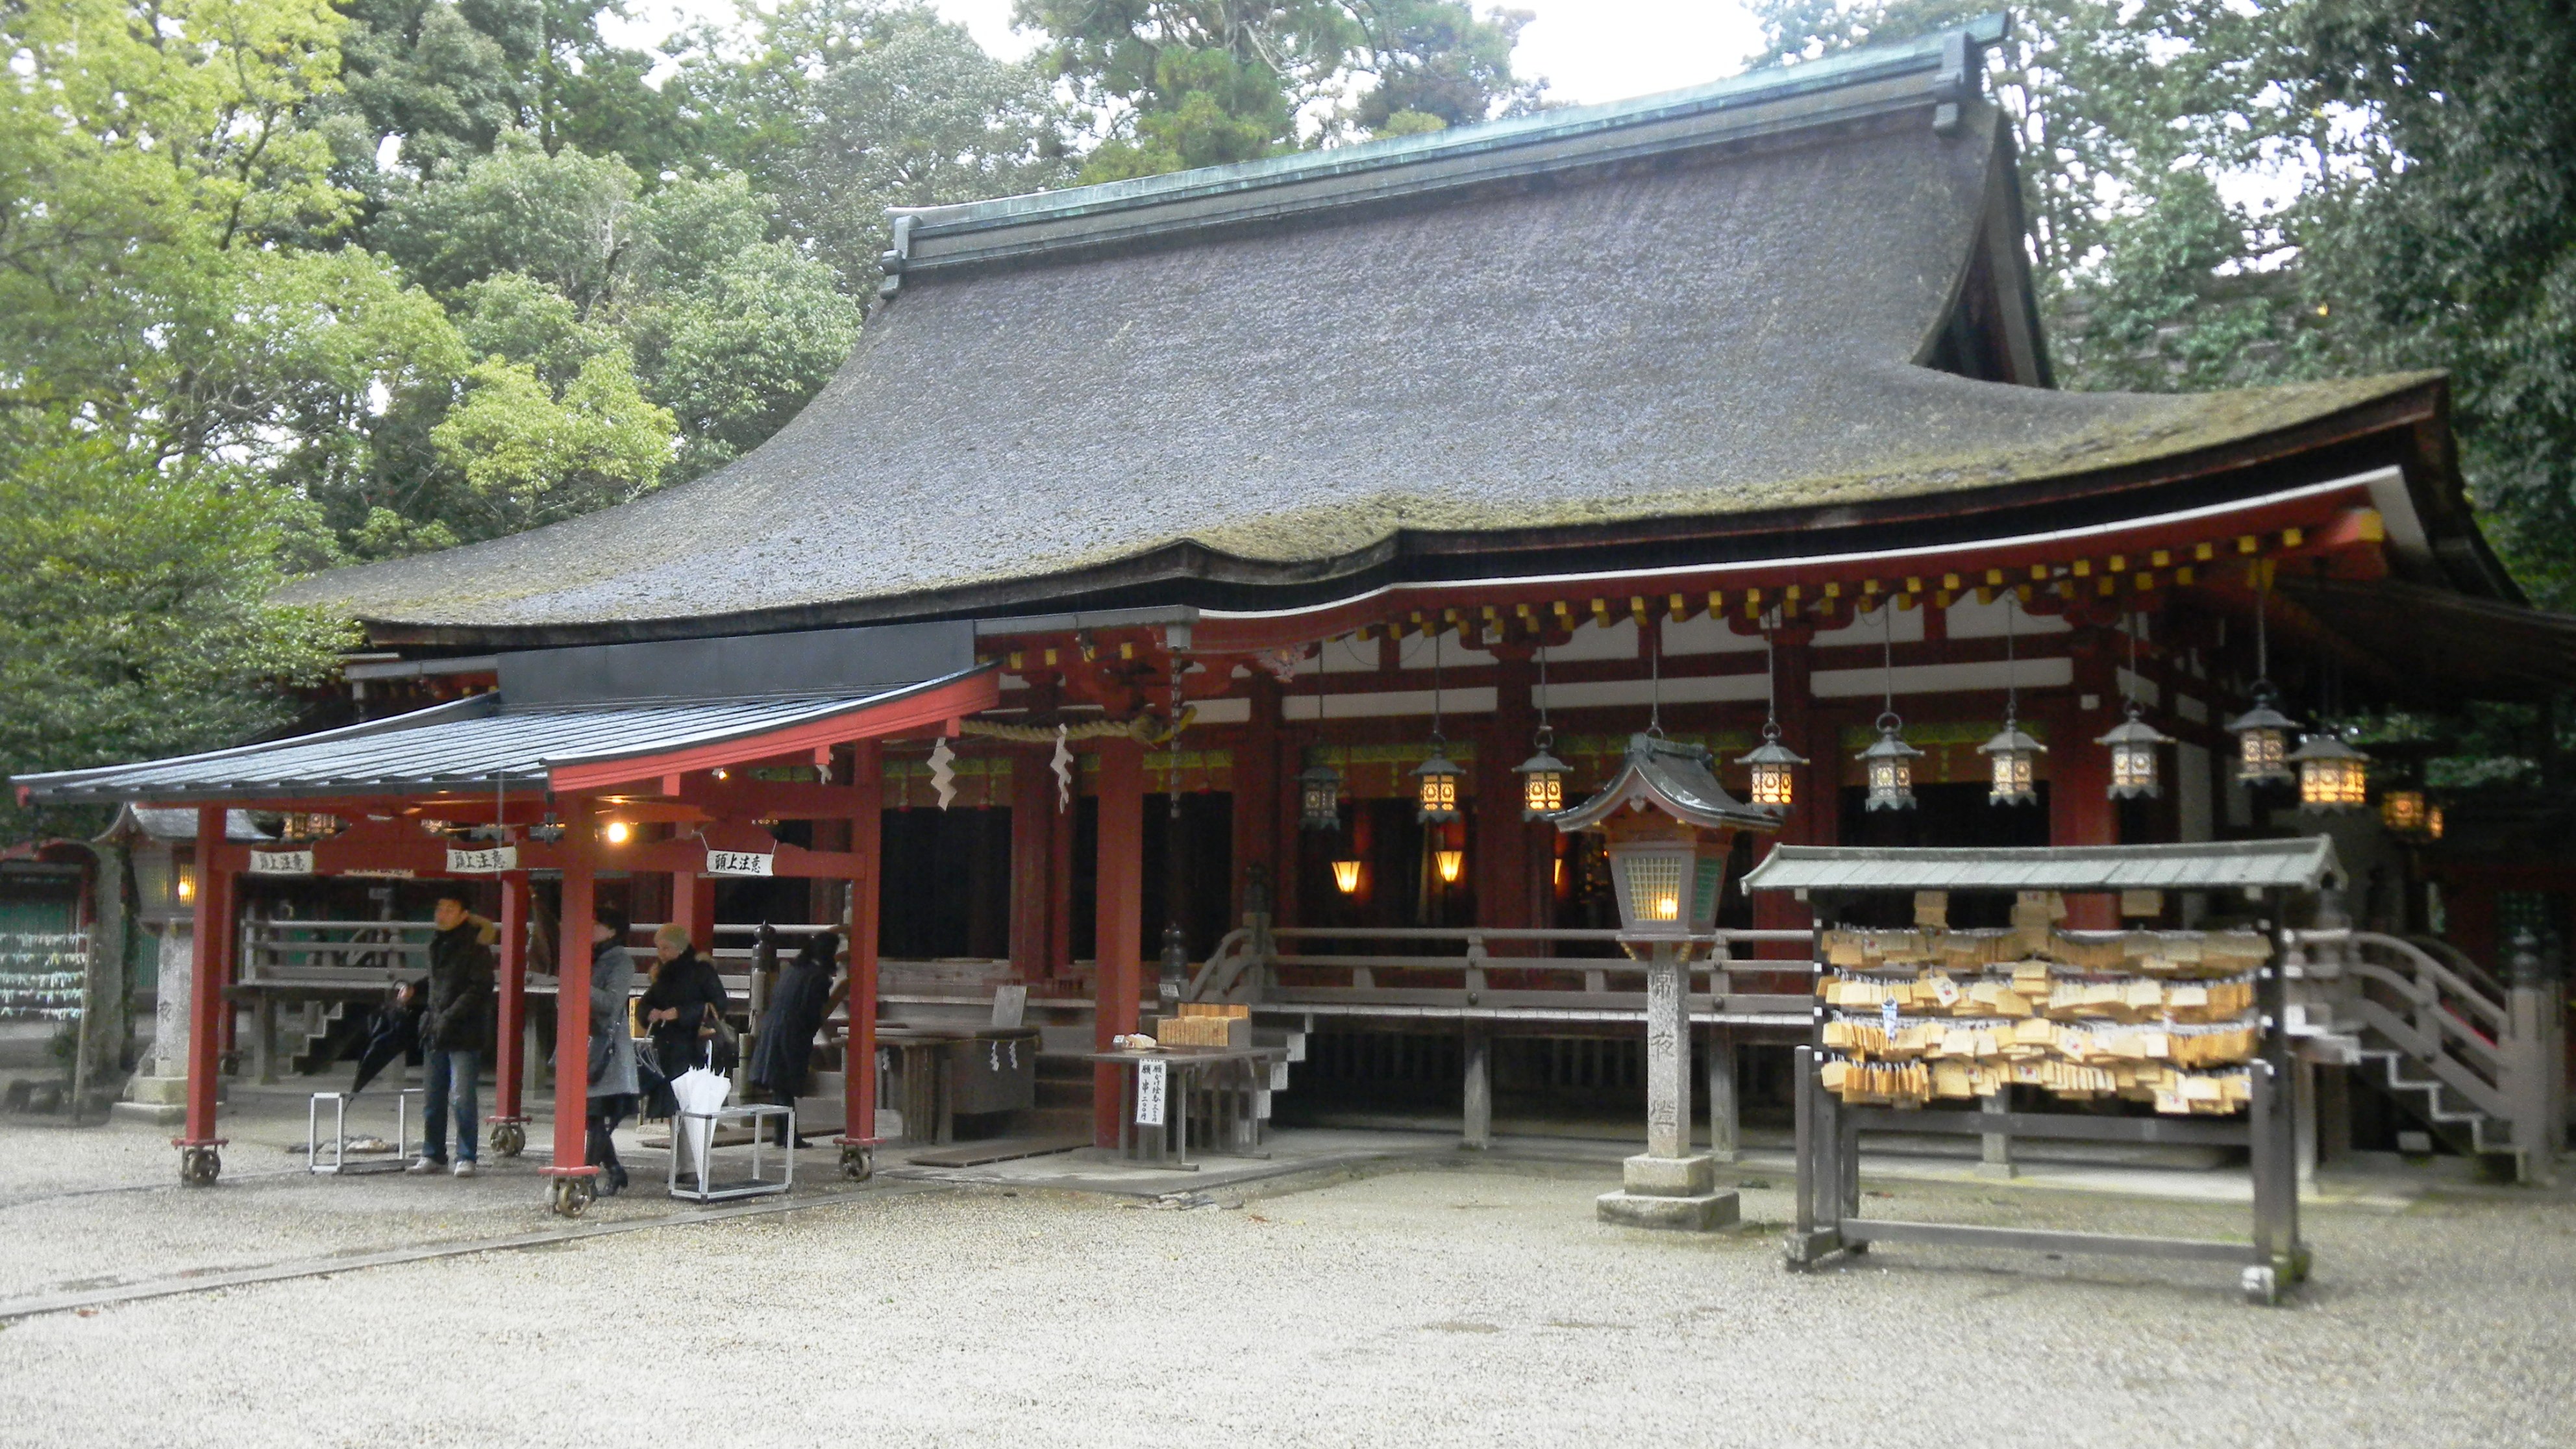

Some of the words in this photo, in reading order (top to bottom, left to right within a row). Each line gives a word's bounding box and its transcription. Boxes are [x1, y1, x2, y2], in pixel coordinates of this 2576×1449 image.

[454, 850, 506, 869] 頭上注意
[715, 853, 761, 873] 頭上注意
